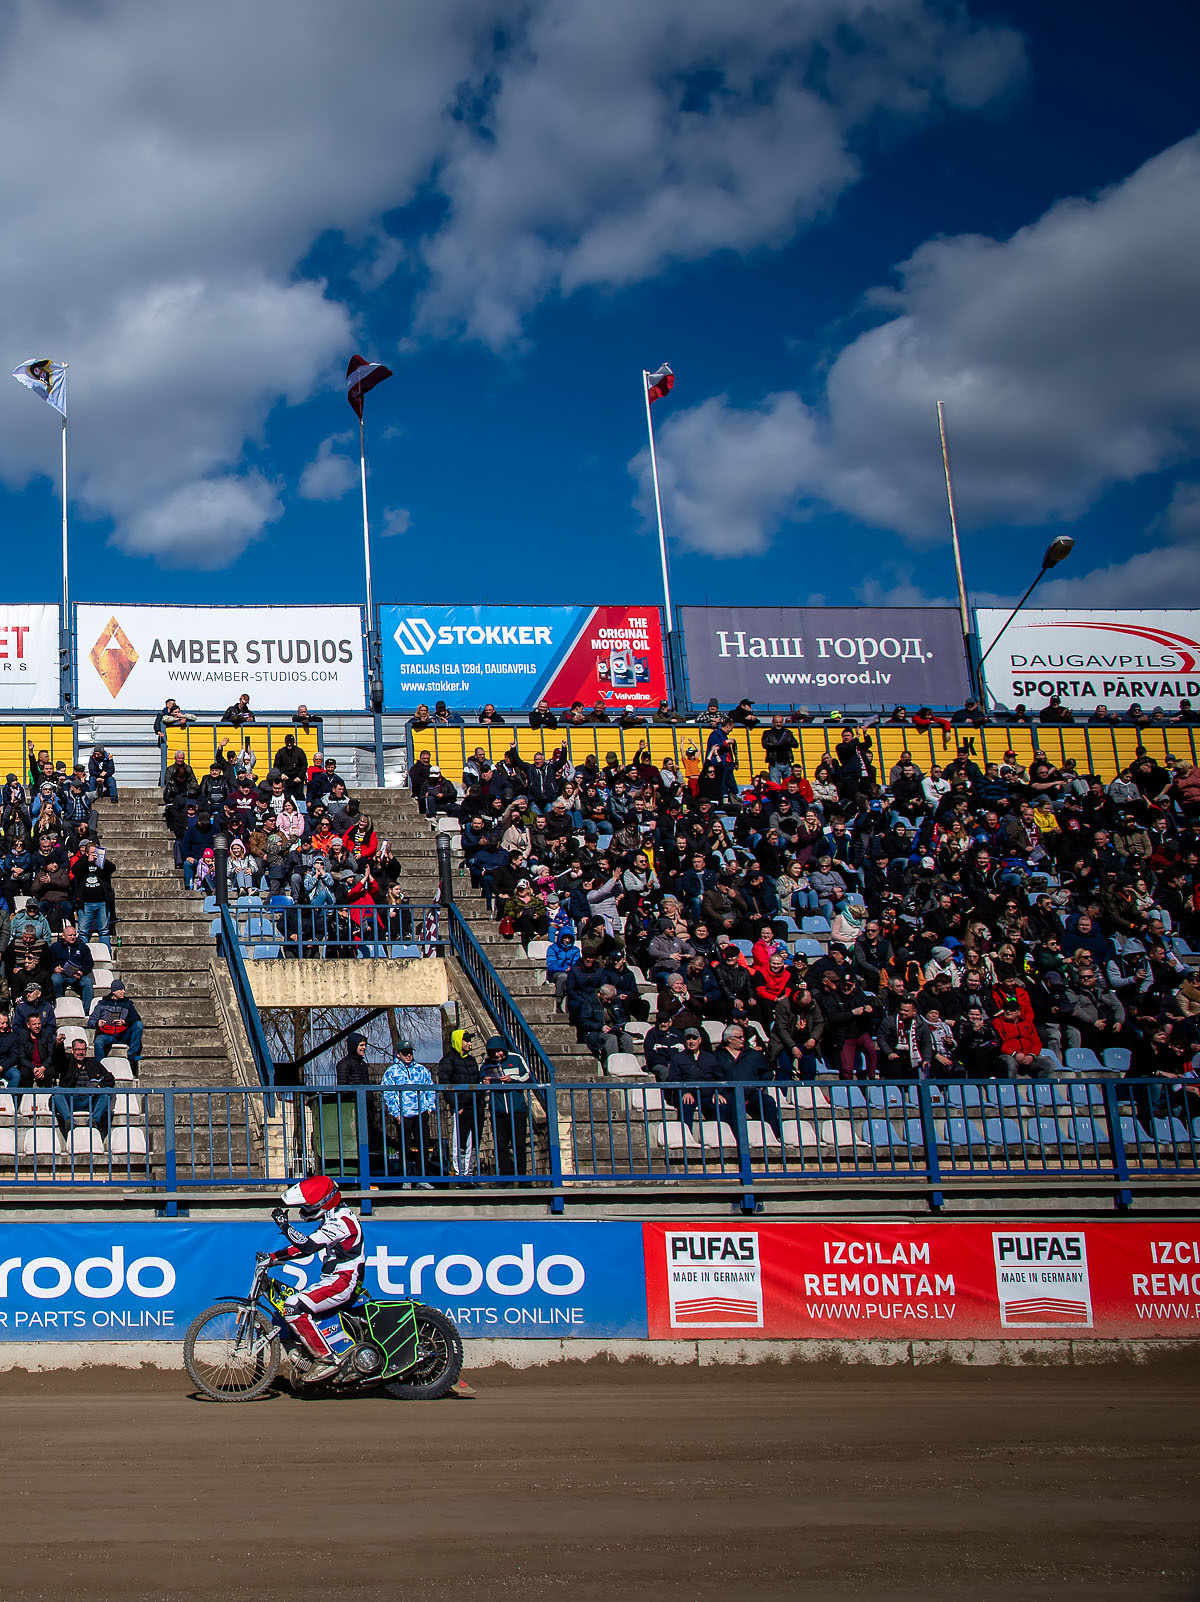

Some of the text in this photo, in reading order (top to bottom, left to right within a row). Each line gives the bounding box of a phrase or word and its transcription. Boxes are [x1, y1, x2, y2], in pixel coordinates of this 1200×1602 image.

[628, 618, 648, 628] THE
[438, 626, 550, 645] STOKKER
[598, 628, 648, 640] ORIGINAL
[149, 638, 353, 664] AMBER STUDIOS
[591, 640, 650, 650] MOTOR OIL
[716, 631, 933, 664] Наш город.
[400, 664, 440, 675] STACIJAS
[442, 664, 460, 675] IELA
[485, 663, 536, 674] DAUGAVPILS
[1010, 654, 1176, 668] DAUGAVPILS
[168, 670, 338, 682] WWW.AMBER-STUDIOS.COM
[766, 671, 892, 686] www.gorod.lv
[401, 680, 470, 692] www.stokker.lv
[1012, 677, 1200, 697] SPORTA PĀRVALD
[672, 1236, 754, 1260] PUFAS
[824, 1242, 930, 1265] IZCILAM
[998, 1237, 1082, 1260] PUFAS
[1150, 1242, 1200, 1264] IZCI
[366, 1244, 585, 1296] trodo
[673, 1272, 756, 1282] MADE IN GERMANY
[1001, 1272, 1084, 1283] MADE IN GERMANY
[805, 1274, 956, 1296] REMONTAM
[15, 1310, 86, 1328] PARTS
[92, 1310, 175, 1327] ONLINE
[437, 1307, 584, 1324] ARTS ONLINE
[806, 1303, 956, 1319] WWW.PUFAS.LV
